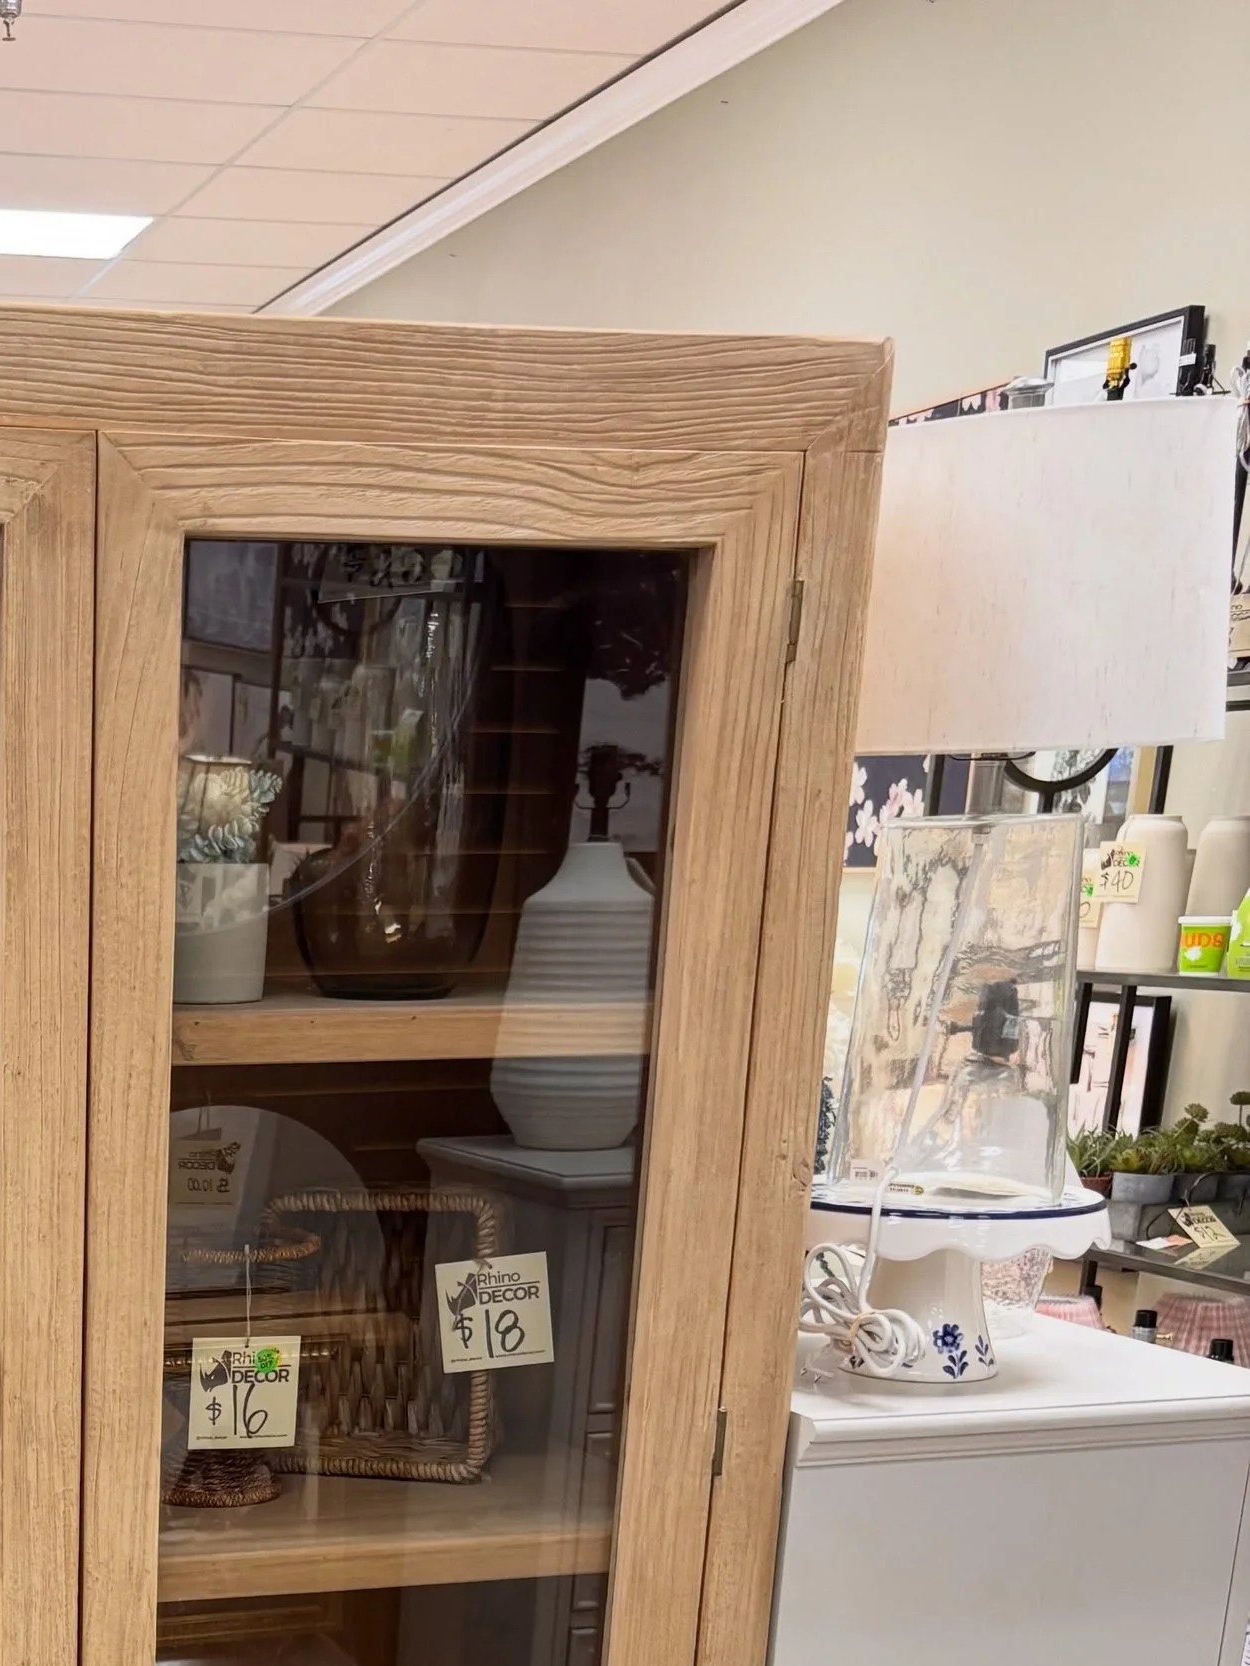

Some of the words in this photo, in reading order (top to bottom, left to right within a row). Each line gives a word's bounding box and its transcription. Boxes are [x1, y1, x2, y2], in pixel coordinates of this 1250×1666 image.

[1100, 870, 1134, 893] $40
[477, 1271, 521, 1286] Rhino
[479, 1285, 540, 1305] DECOR
[454, 1309, 525, 1359] $18
[232, 1350, 255, 1365] Rhi
[231, 1368, 290, 1384] DECOR
